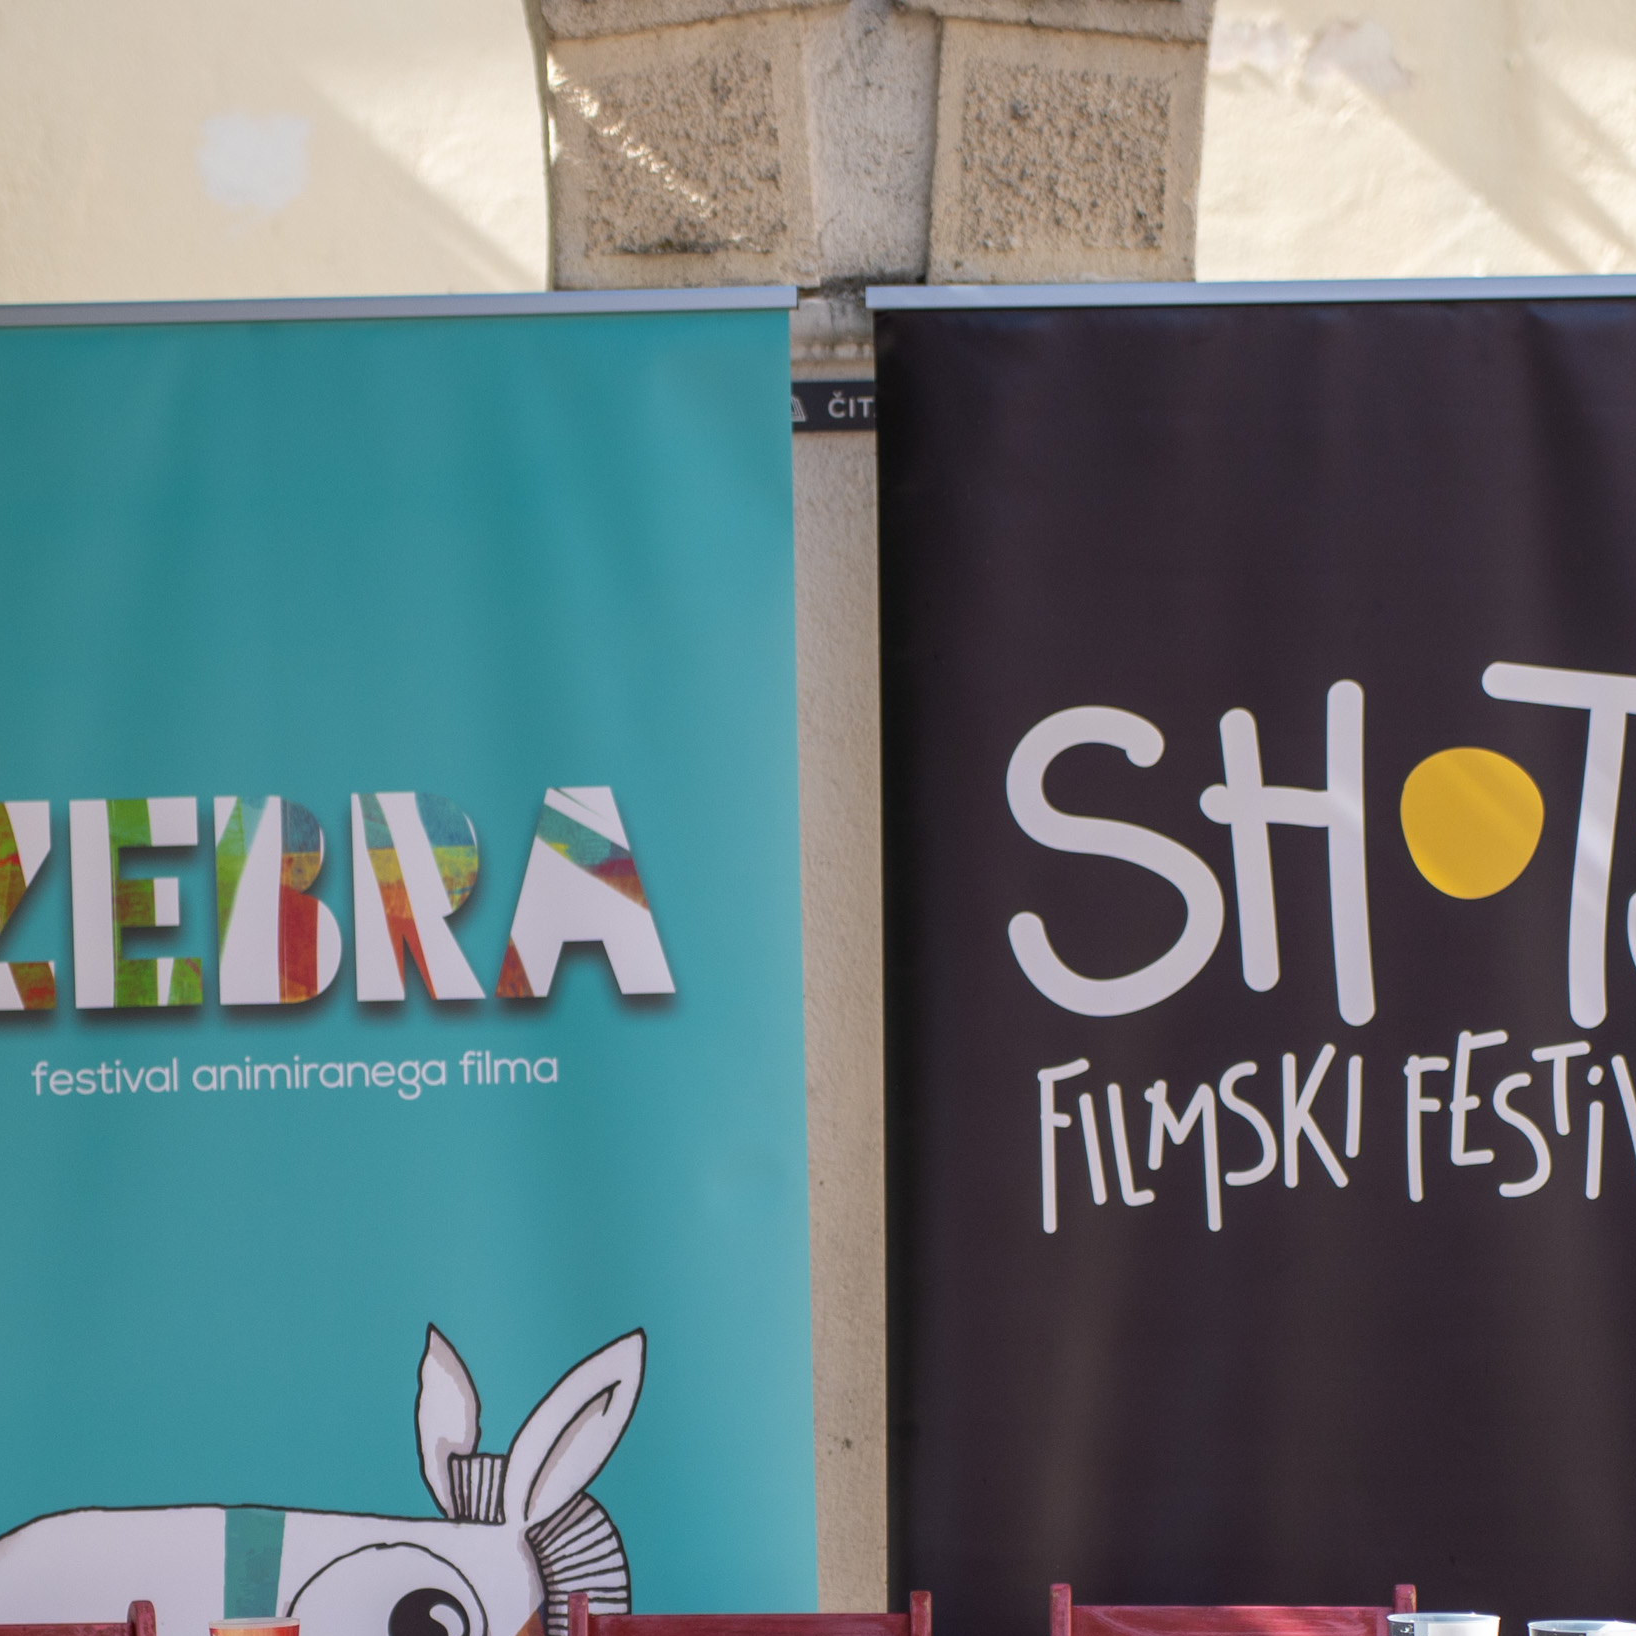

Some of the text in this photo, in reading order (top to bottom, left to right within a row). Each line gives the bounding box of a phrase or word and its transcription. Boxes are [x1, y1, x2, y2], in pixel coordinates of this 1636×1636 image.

[827, 390, 875, 419] ČIT
[31, 1050, 559, 1100] festival animiranega filma
[1038, 1043, 1362, 1233] FILMSKI
